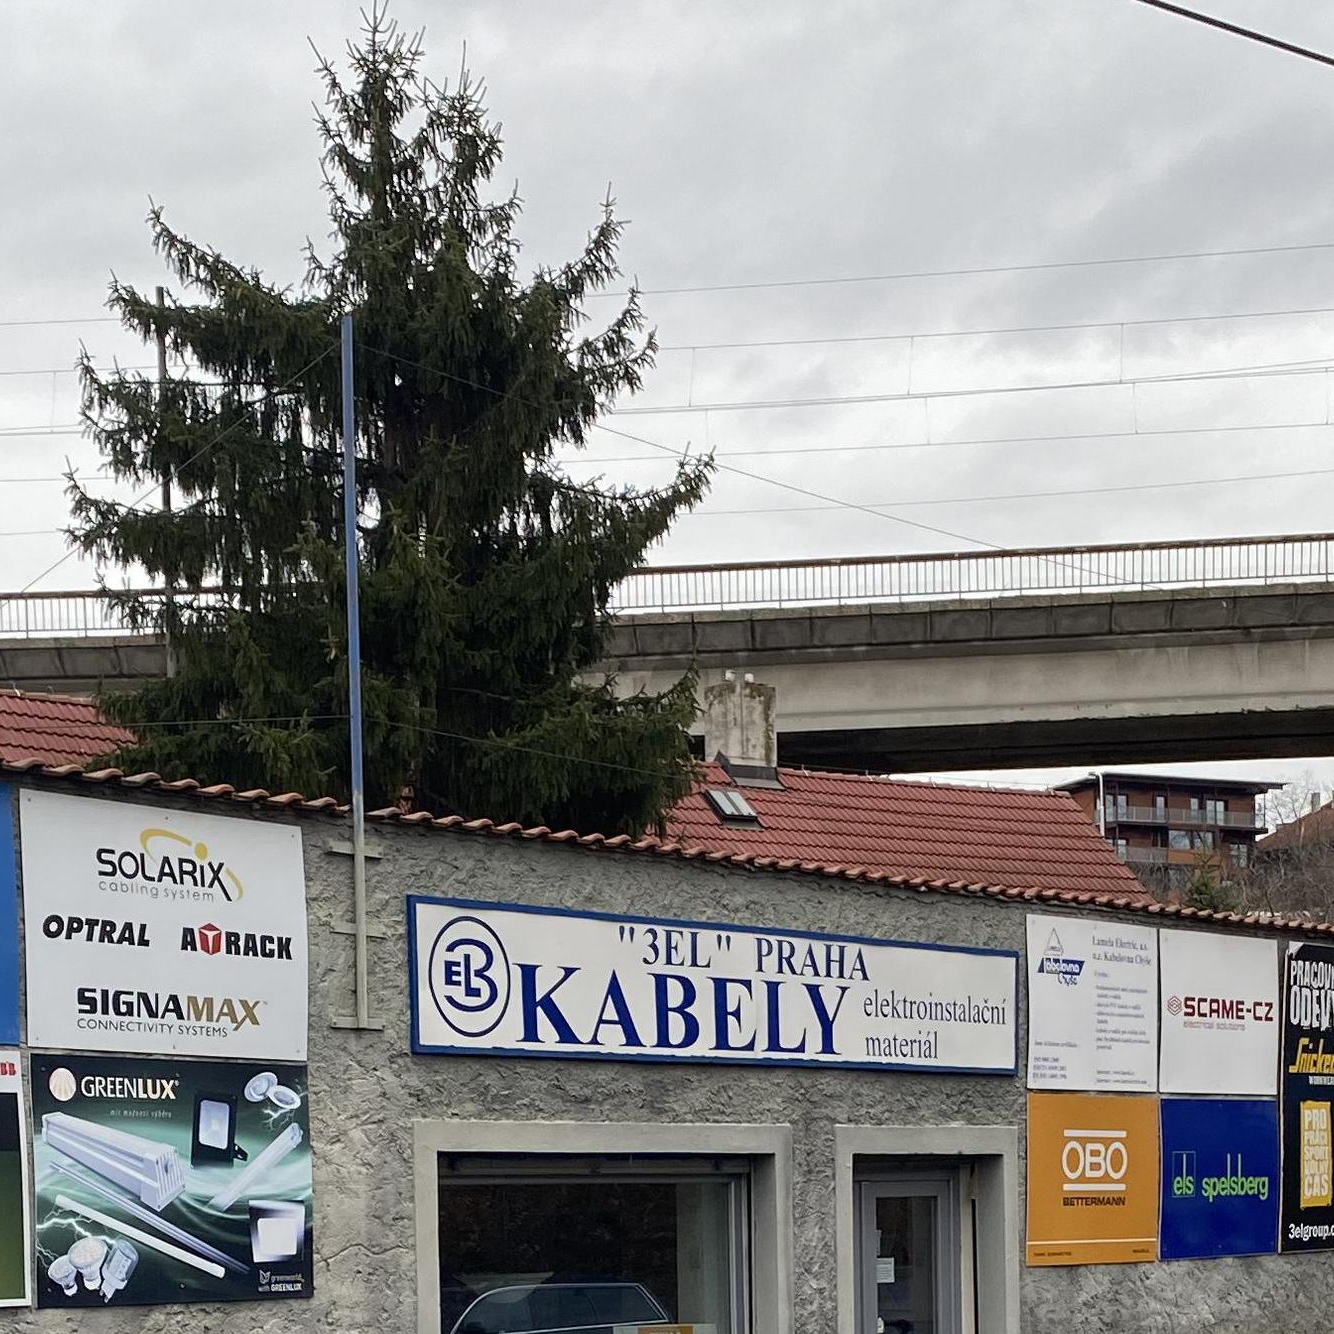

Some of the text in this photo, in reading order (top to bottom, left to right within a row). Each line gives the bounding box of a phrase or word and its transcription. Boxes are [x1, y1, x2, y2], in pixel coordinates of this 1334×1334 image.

[98, 880, 214, 901] cabling system
[42, 914, 151, 947] OPTRAL
[754, 936, 870, 982] PRAHA
[77, 987, 261, 1032] SIGNAMAX
[512, 962, 850, 1056] KABELY
[863, 989, 1007, 1026] elektroinstalační
[1183, 996, 1273, 1022] SCAME-CZ
[77, 1018, 228, 1038] CONNECTIVITY SYSTEMS
[865, 1030, 940, 1060] materiál
[81, 1076, 176, 1100] GREENLUX
[1062, 1141, 1128, 1179] OBO
[1173, 1153, 1269, 1202] els spelsberg
[1062, 1197, 1126, 1207] BETTERMANN
